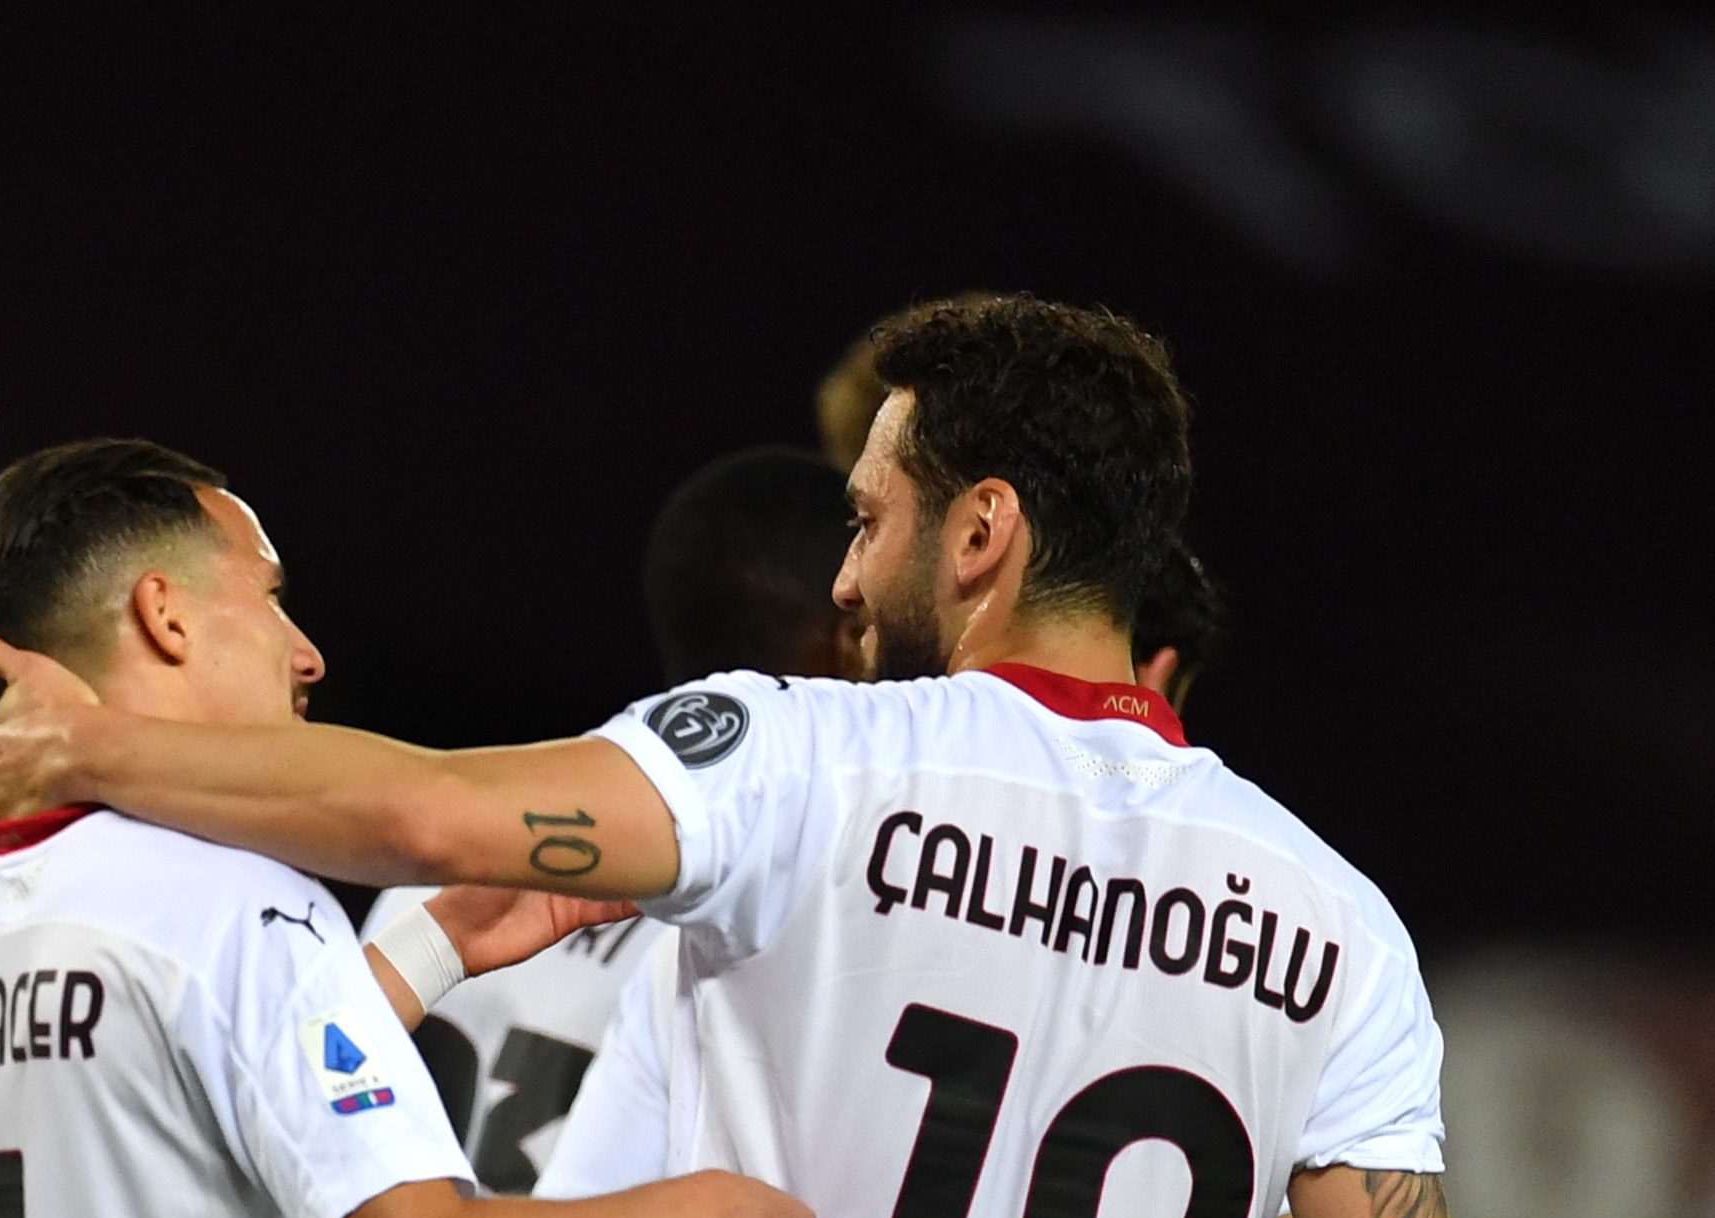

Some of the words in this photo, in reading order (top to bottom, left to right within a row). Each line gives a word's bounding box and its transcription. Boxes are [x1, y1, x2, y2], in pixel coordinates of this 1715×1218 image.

[1102, 695, 1150, 717] ACM
[522, 808, 602, 877] 10
[866, 811, 1340, 1023] ÇALHANOĞLU
